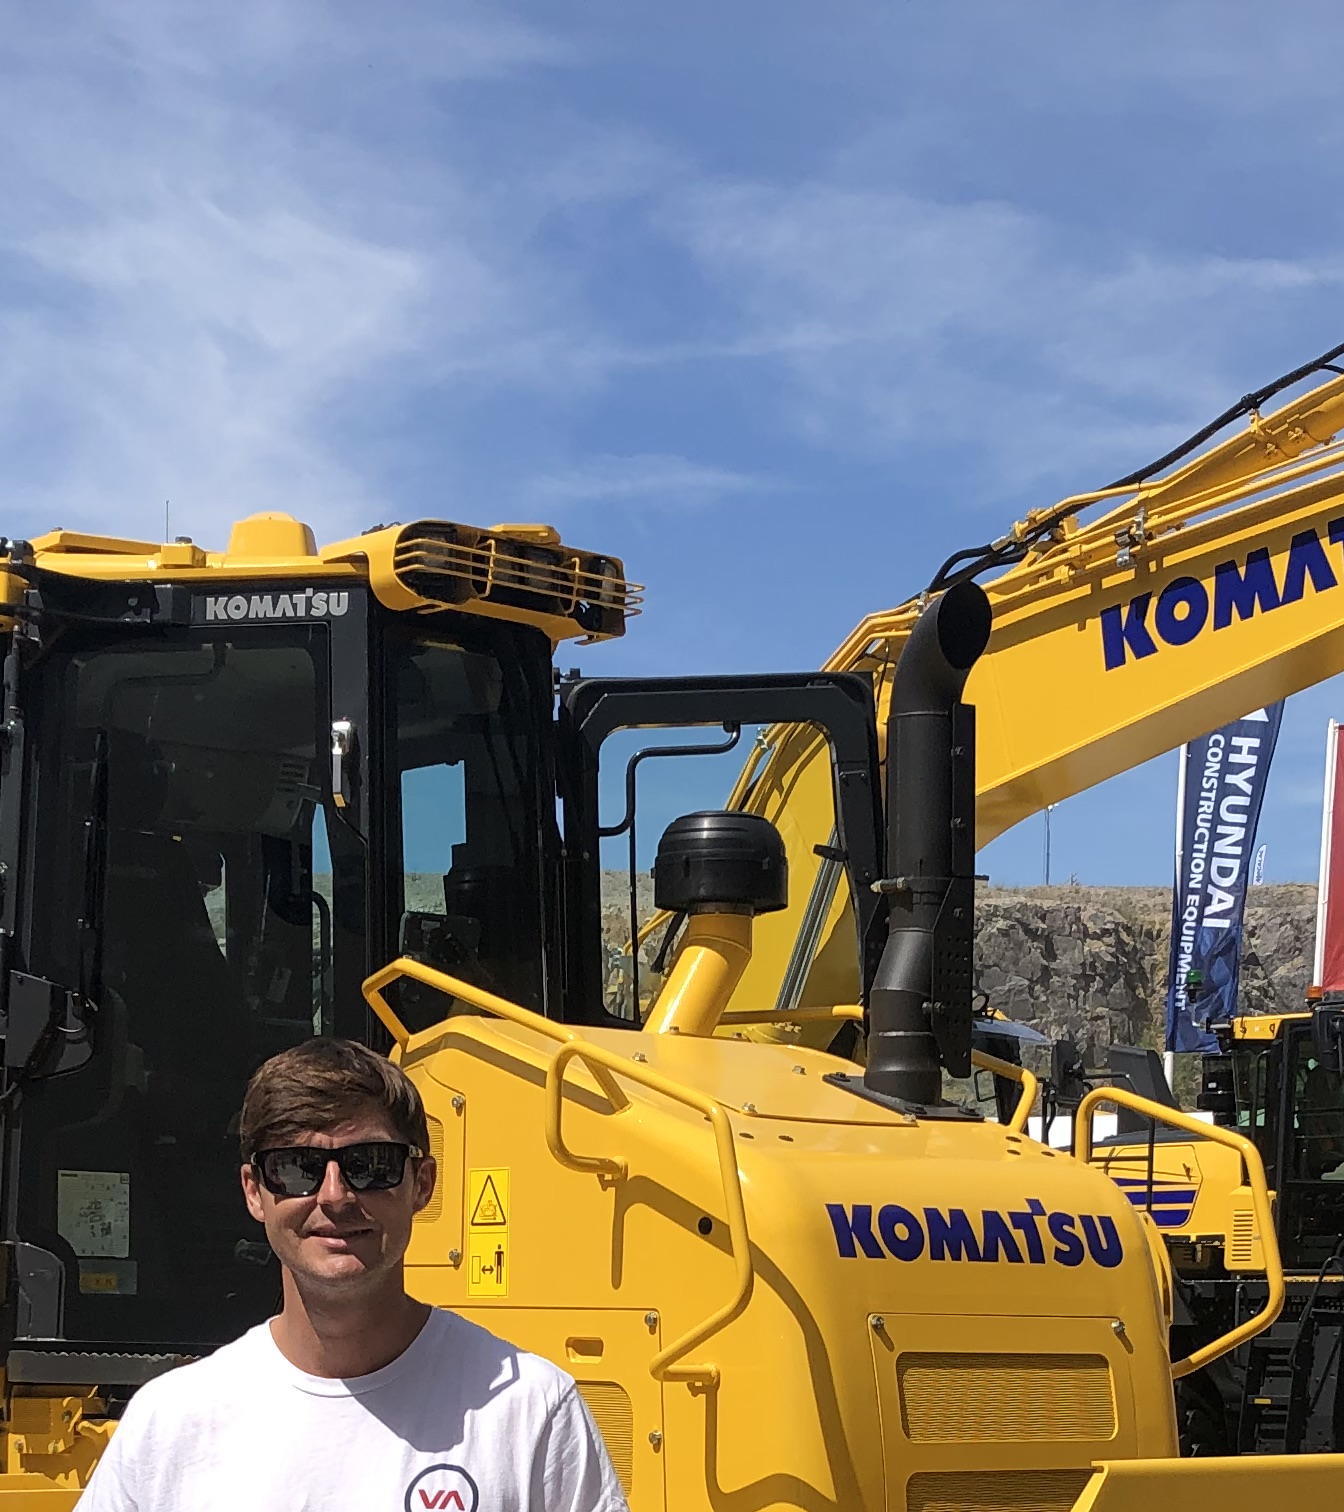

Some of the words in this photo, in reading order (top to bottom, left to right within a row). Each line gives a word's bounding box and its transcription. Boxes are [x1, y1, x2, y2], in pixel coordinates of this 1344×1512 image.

[206, 588, 349, 621] KOMATSU
[1188, 733, 1225, 889] CONSTRUCTION
[1202, 736, 1260, 929] HYUNDAI
[825, 1198, 1124, 1269] KOMATSU
